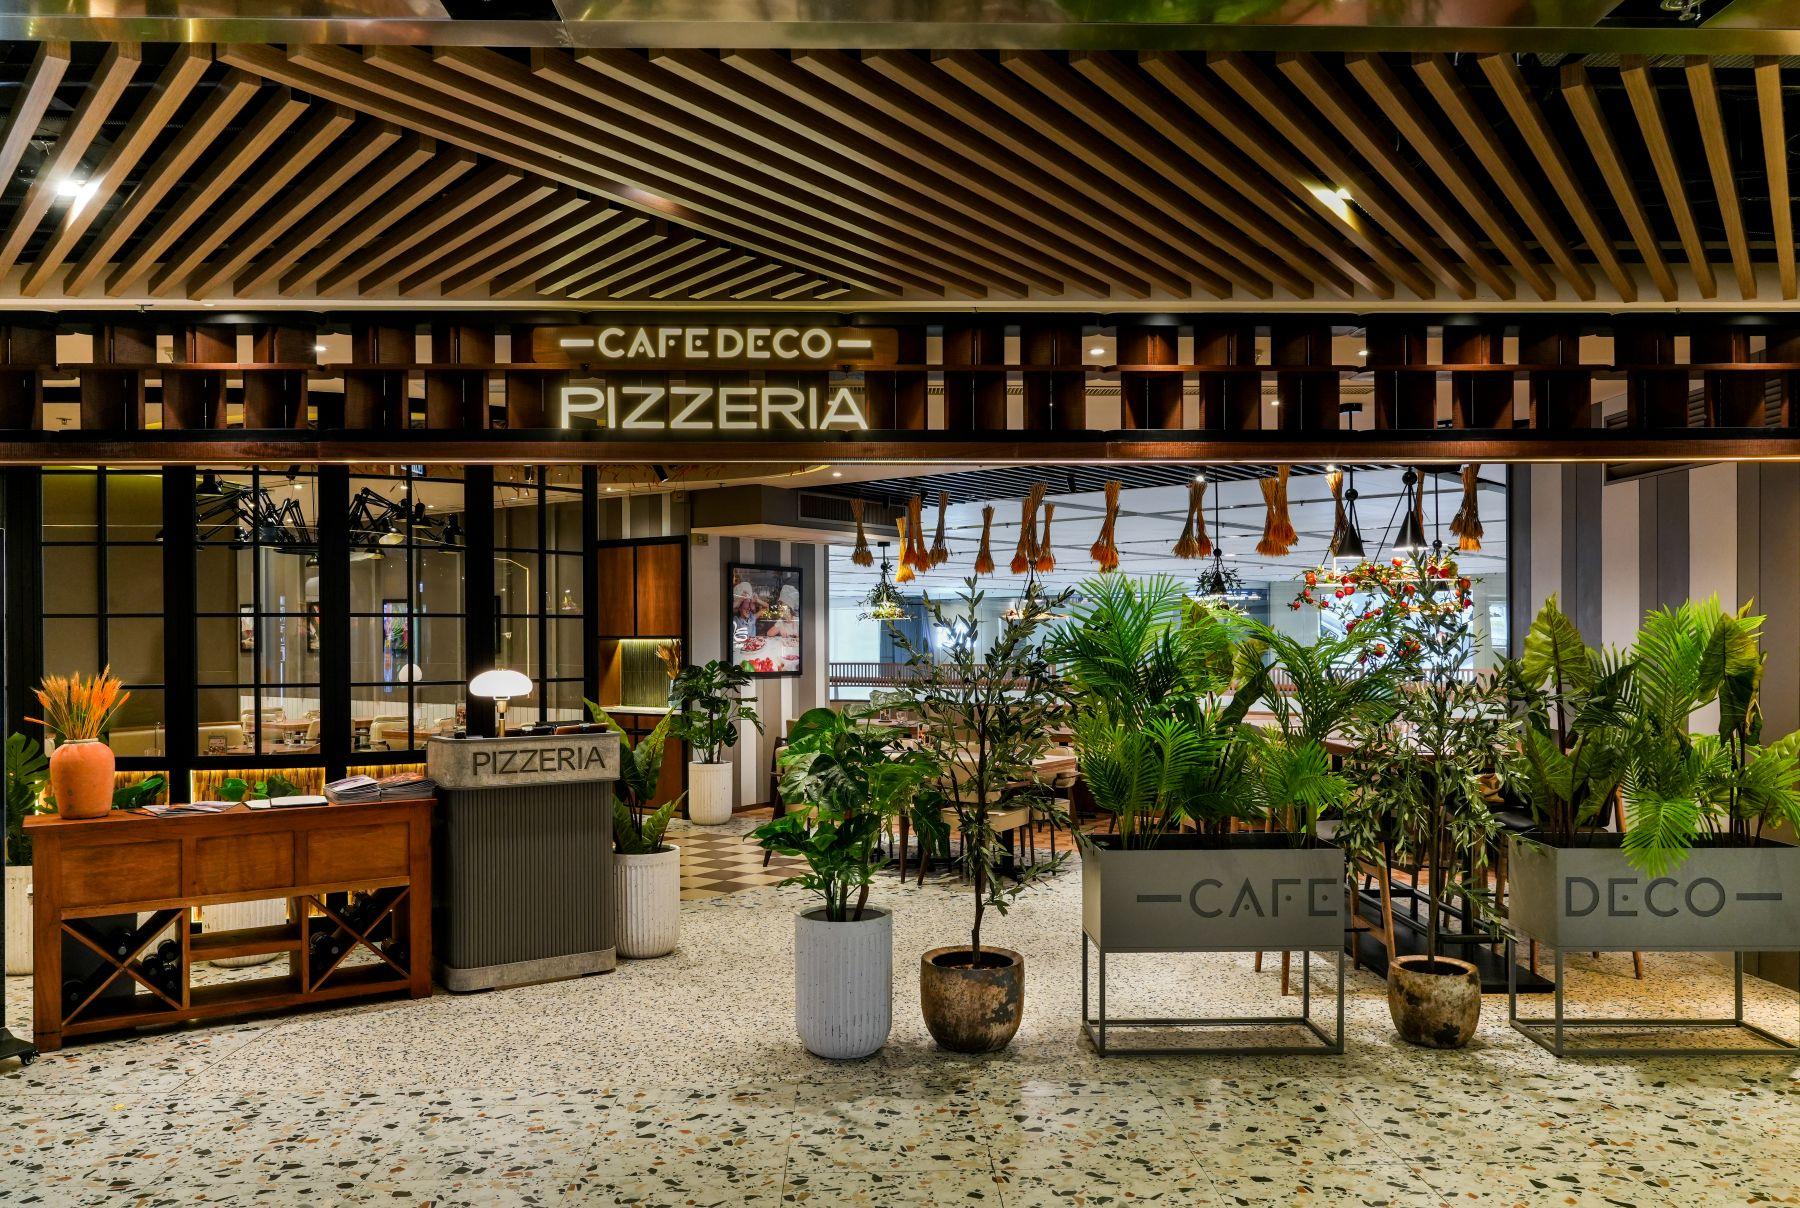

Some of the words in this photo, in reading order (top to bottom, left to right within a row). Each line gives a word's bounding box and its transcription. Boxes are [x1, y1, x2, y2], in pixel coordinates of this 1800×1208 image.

[597, 327, 710, 359] CAFE
[716, 327, 833, 359] DECO
[560, 386, 868, 430] PIZZERIA
[472, 746, 606, 776] PIZZERIA
[1189, 877, 1339, 918] CAFE
[1565, 876, 1725, 918] DECO
